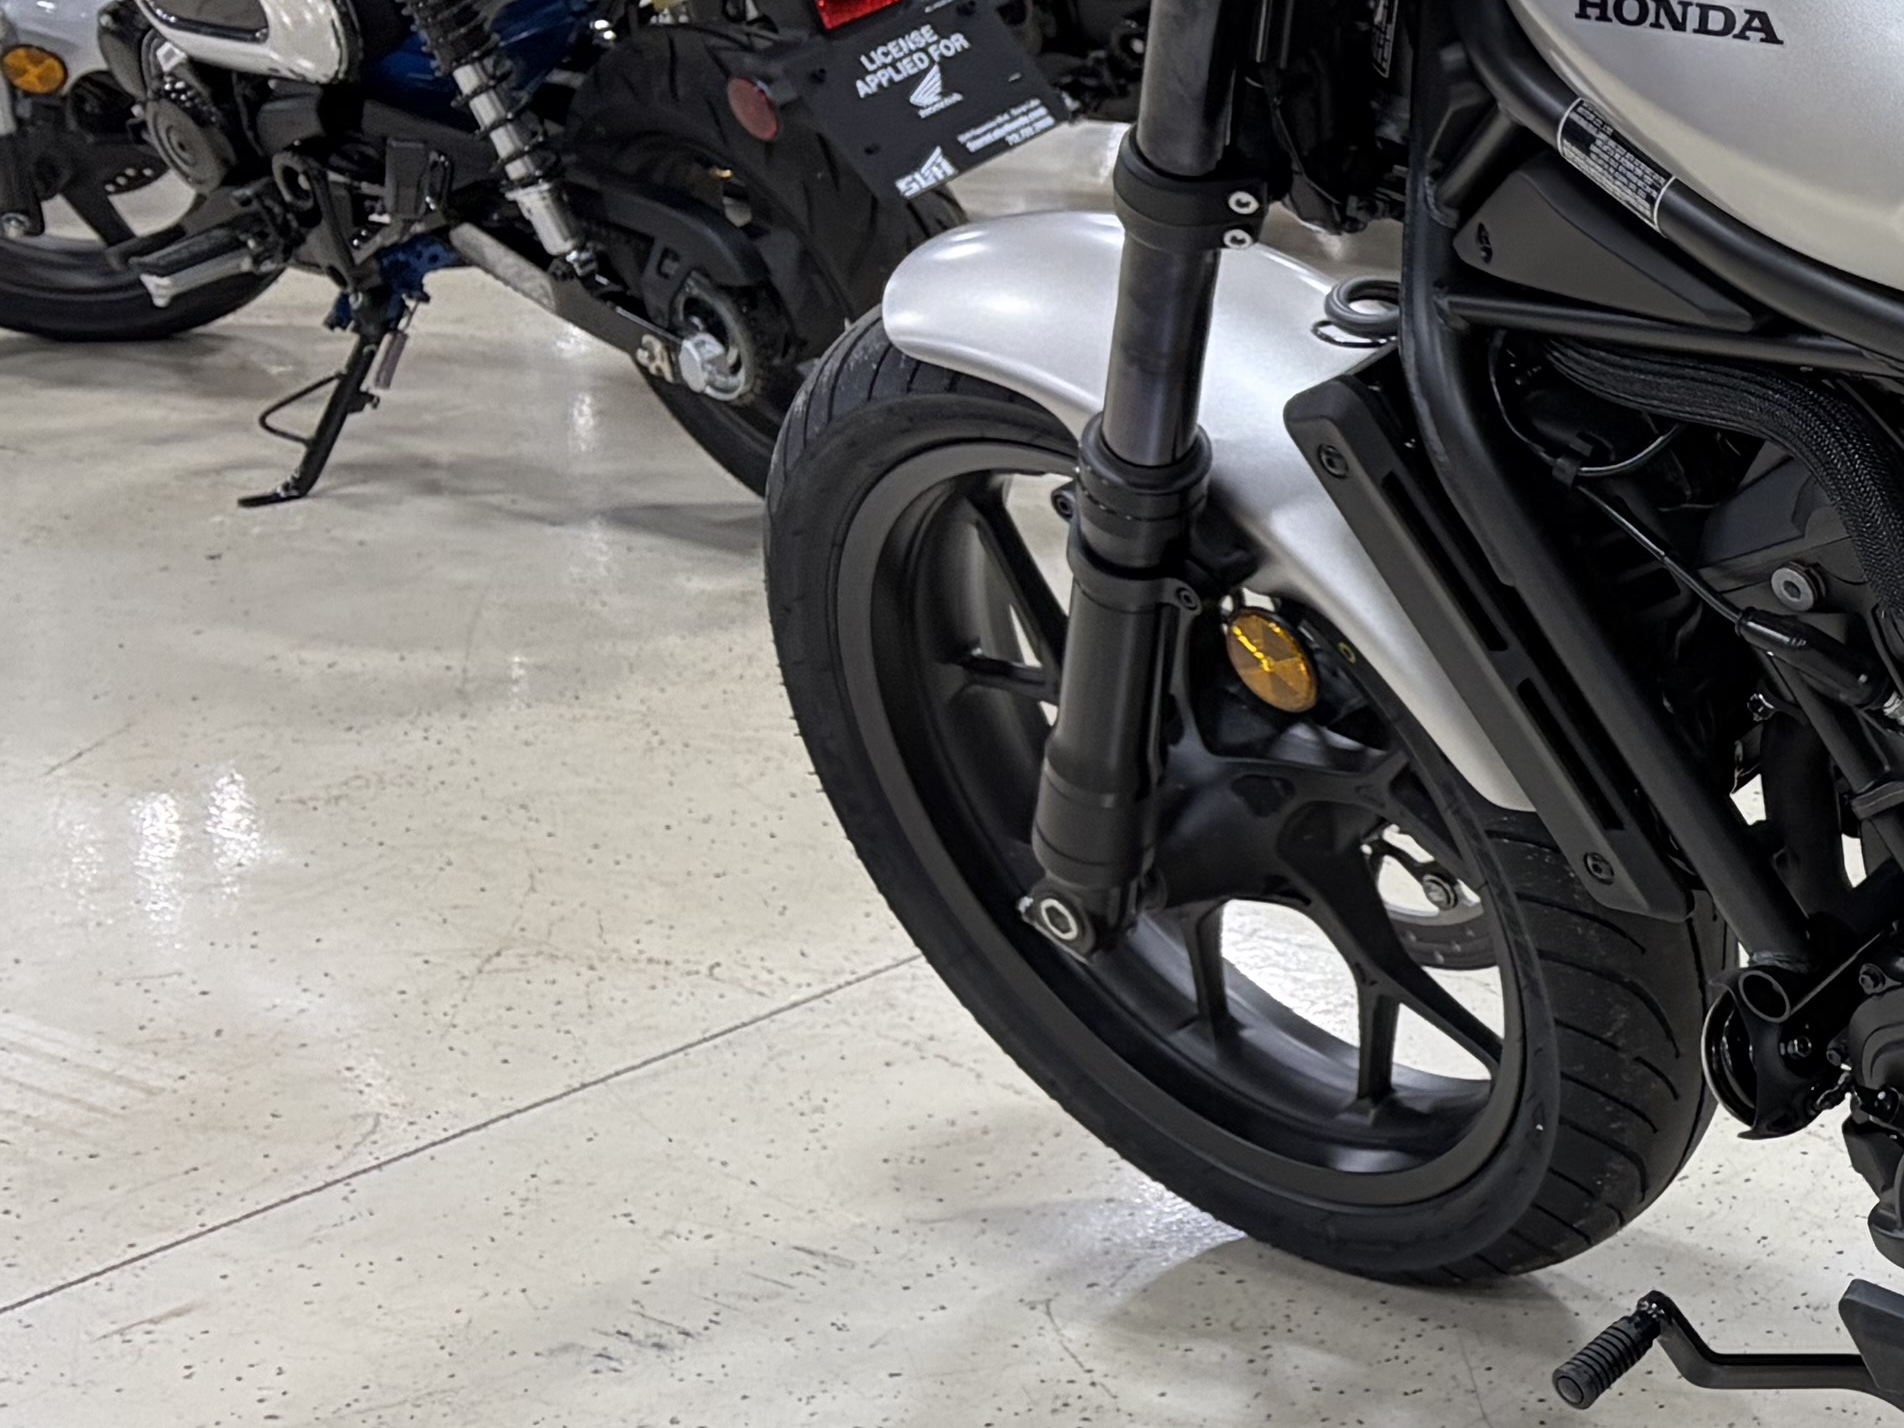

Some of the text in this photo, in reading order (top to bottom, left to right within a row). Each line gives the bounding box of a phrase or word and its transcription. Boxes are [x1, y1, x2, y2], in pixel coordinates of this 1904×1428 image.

[856, 33, 970, 98] APPLIED FOR
[860, 24, 938, 72] LICENSE
